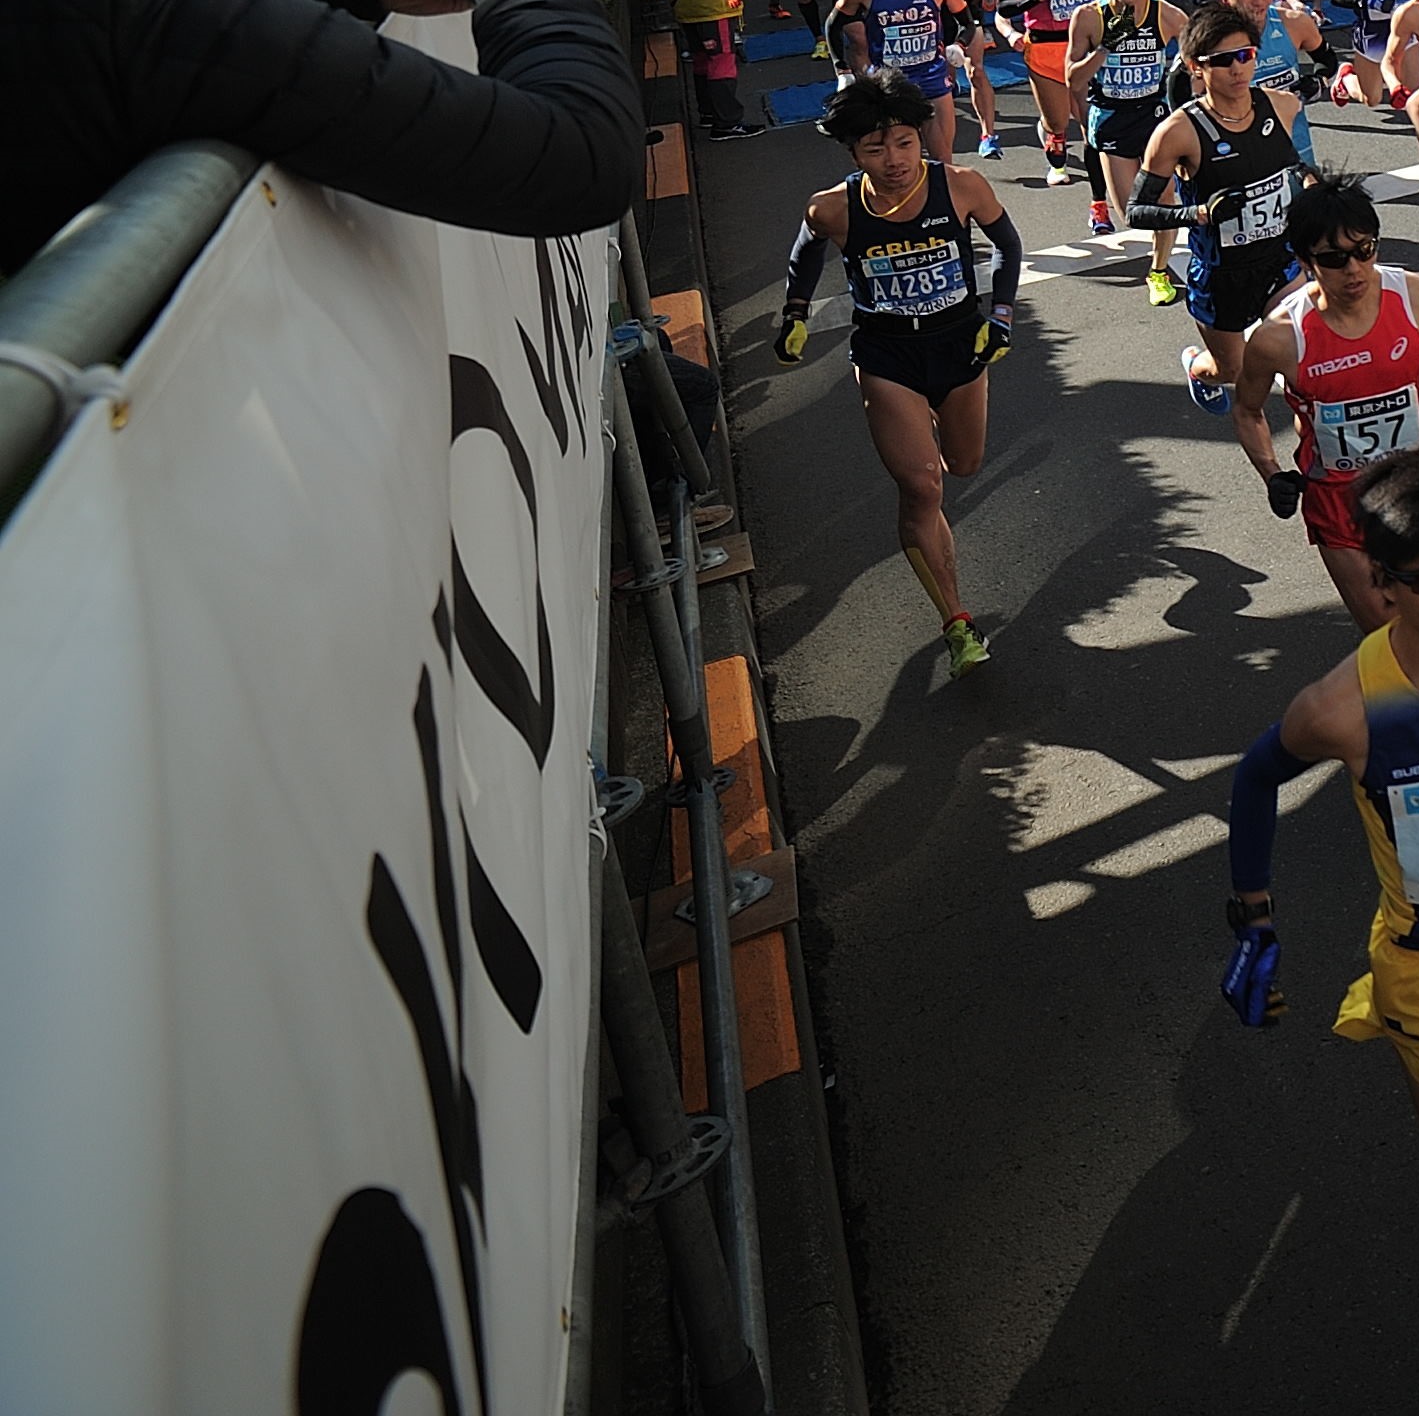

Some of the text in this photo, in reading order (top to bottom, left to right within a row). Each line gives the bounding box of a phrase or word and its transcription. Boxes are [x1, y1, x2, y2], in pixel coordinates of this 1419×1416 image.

[883, 35, 930, 55] A4007
[1103, 67, 1152, 84] A4083
[1237, 193, 1283, 232] 154
[895, 249, 947, 269] 東京メトロ
[873, 266, 948, 301] A4285
[1349, 395, 1407, 417] 東京メトロ
[1337, 413, 1405, 457] 157
